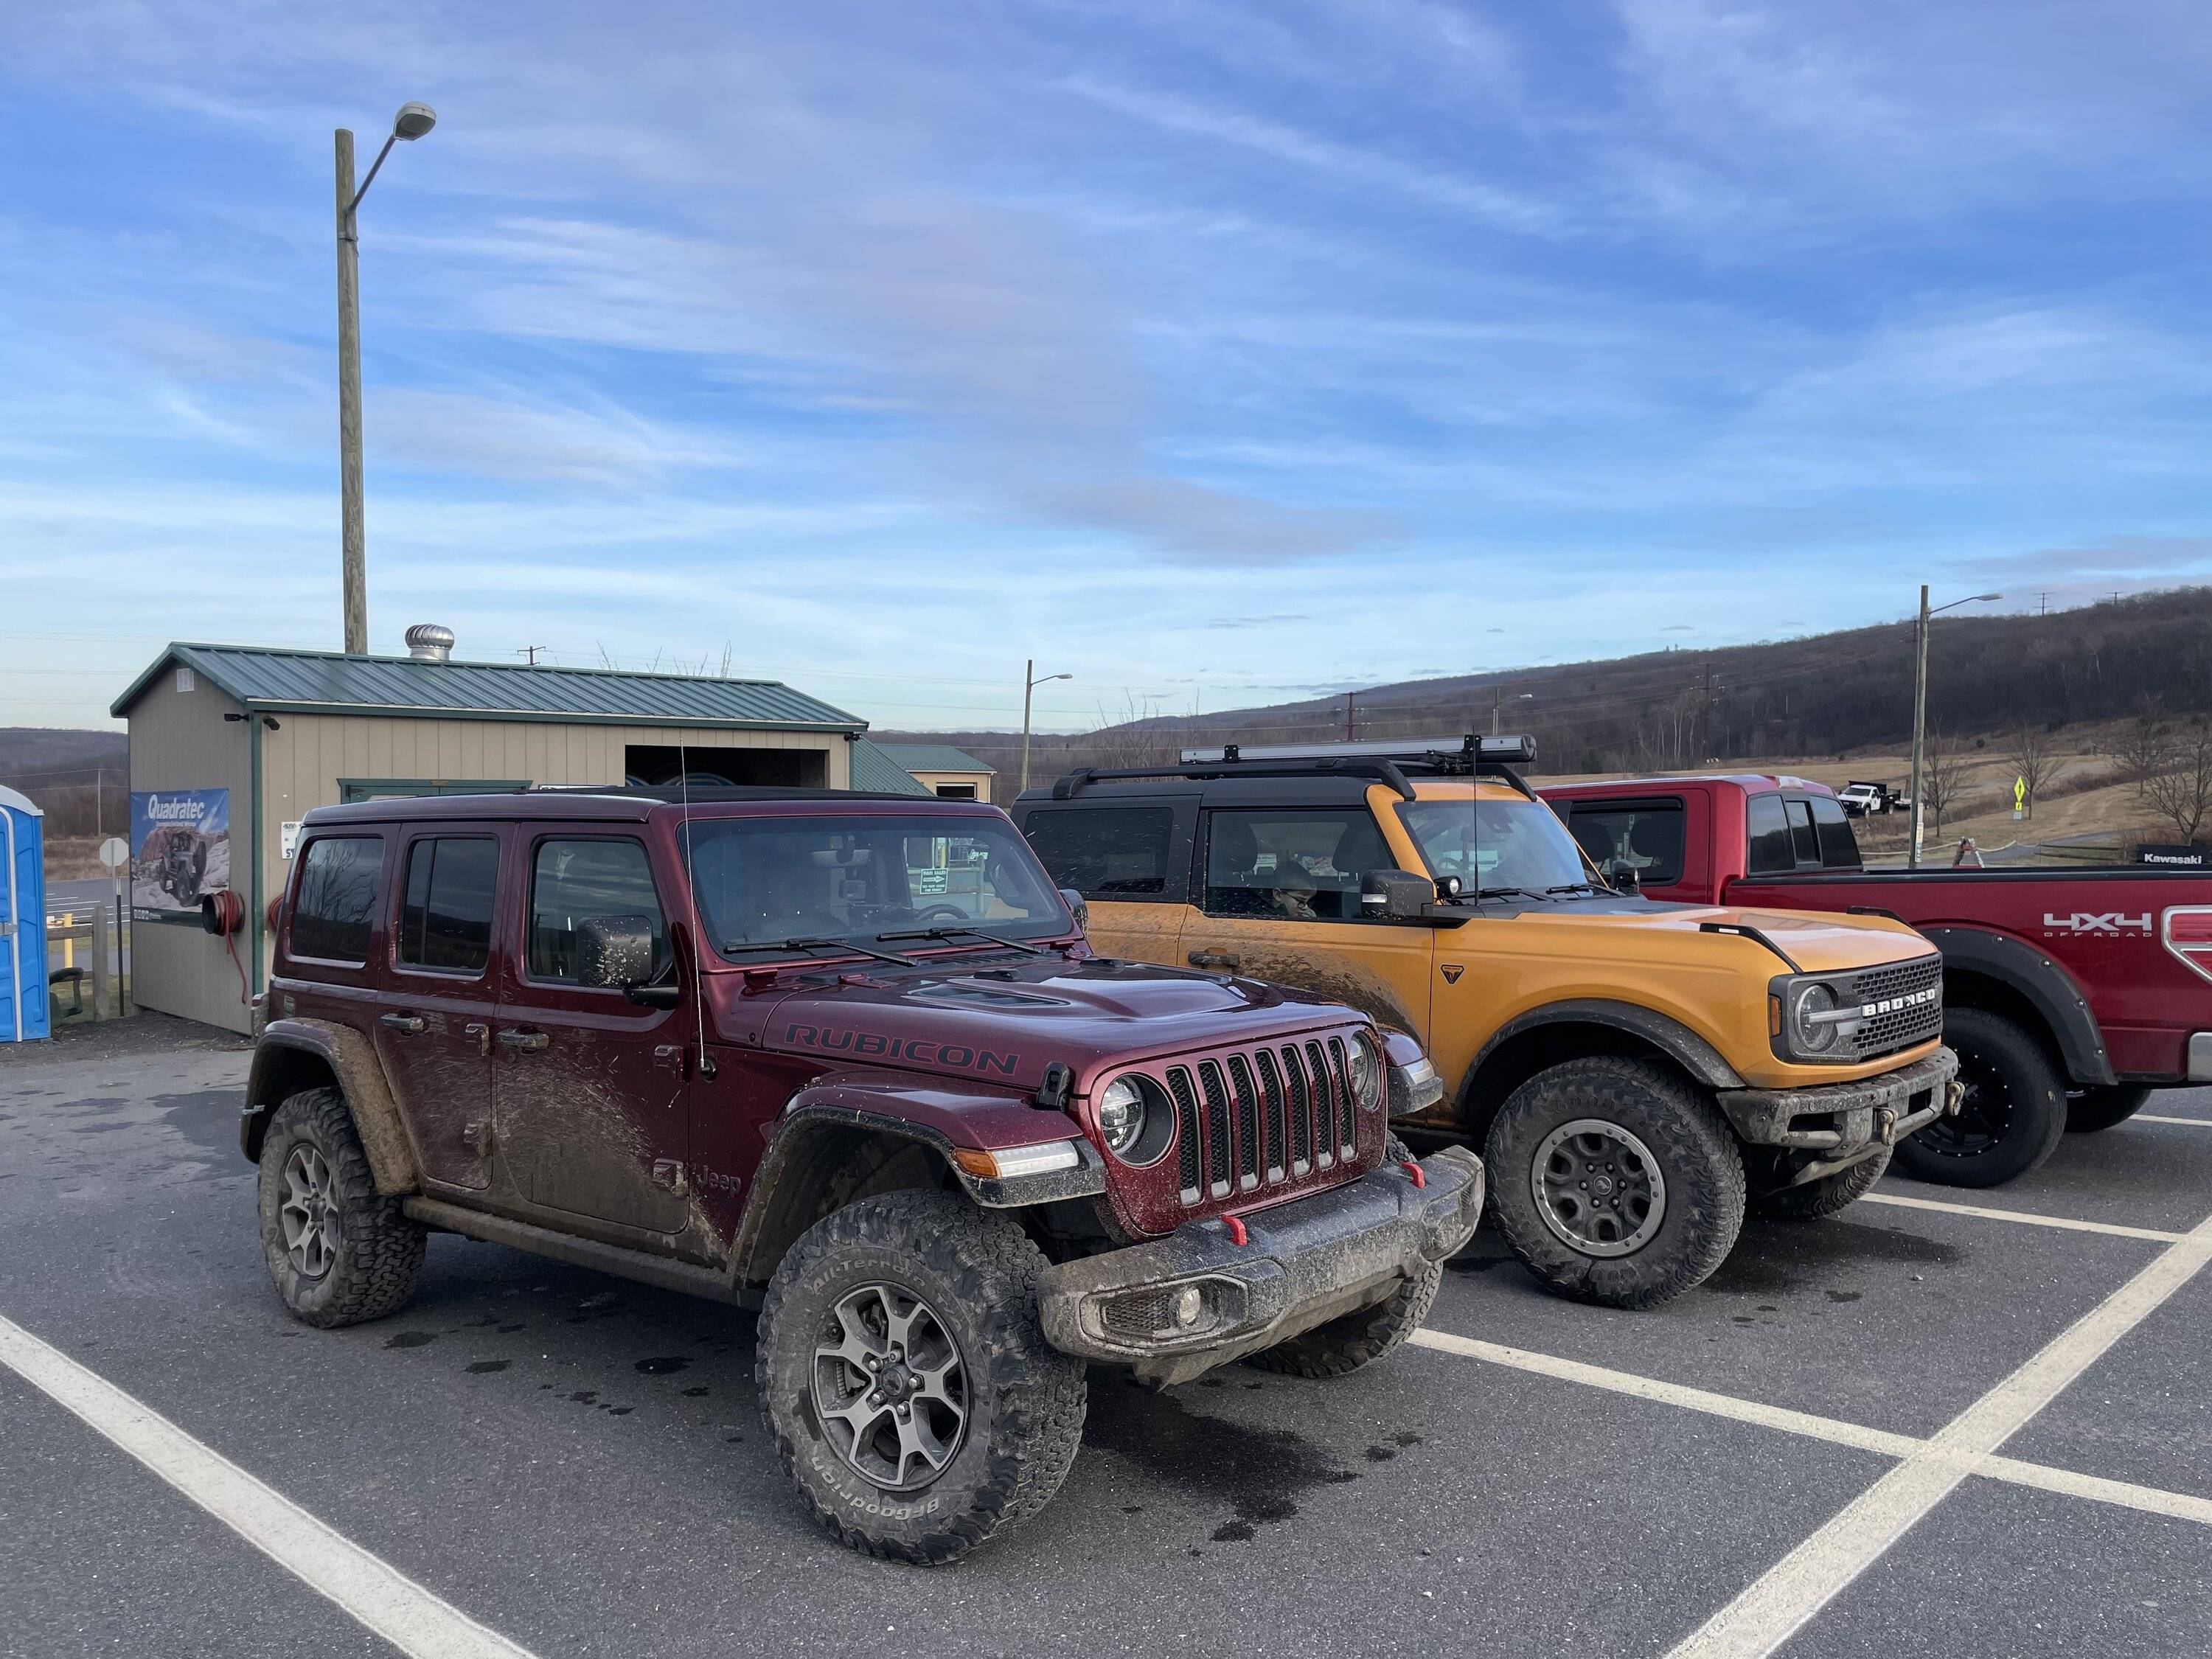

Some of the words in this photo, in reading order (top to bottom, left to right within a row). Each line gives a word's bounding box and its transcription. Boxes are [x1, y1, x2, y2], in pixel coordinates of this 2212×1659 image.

[148, 794, 205, 820] Quadratec
[2144, 853, 2202, 865] Kawasaki
[1862, 989, 1935, 1016] BRONCO
[785, 1023, 1020, 1076] RUBICON
[696, 1165, 741, 1198] Jeep
[811, 1456, 939, 1520] BFGoodrich
